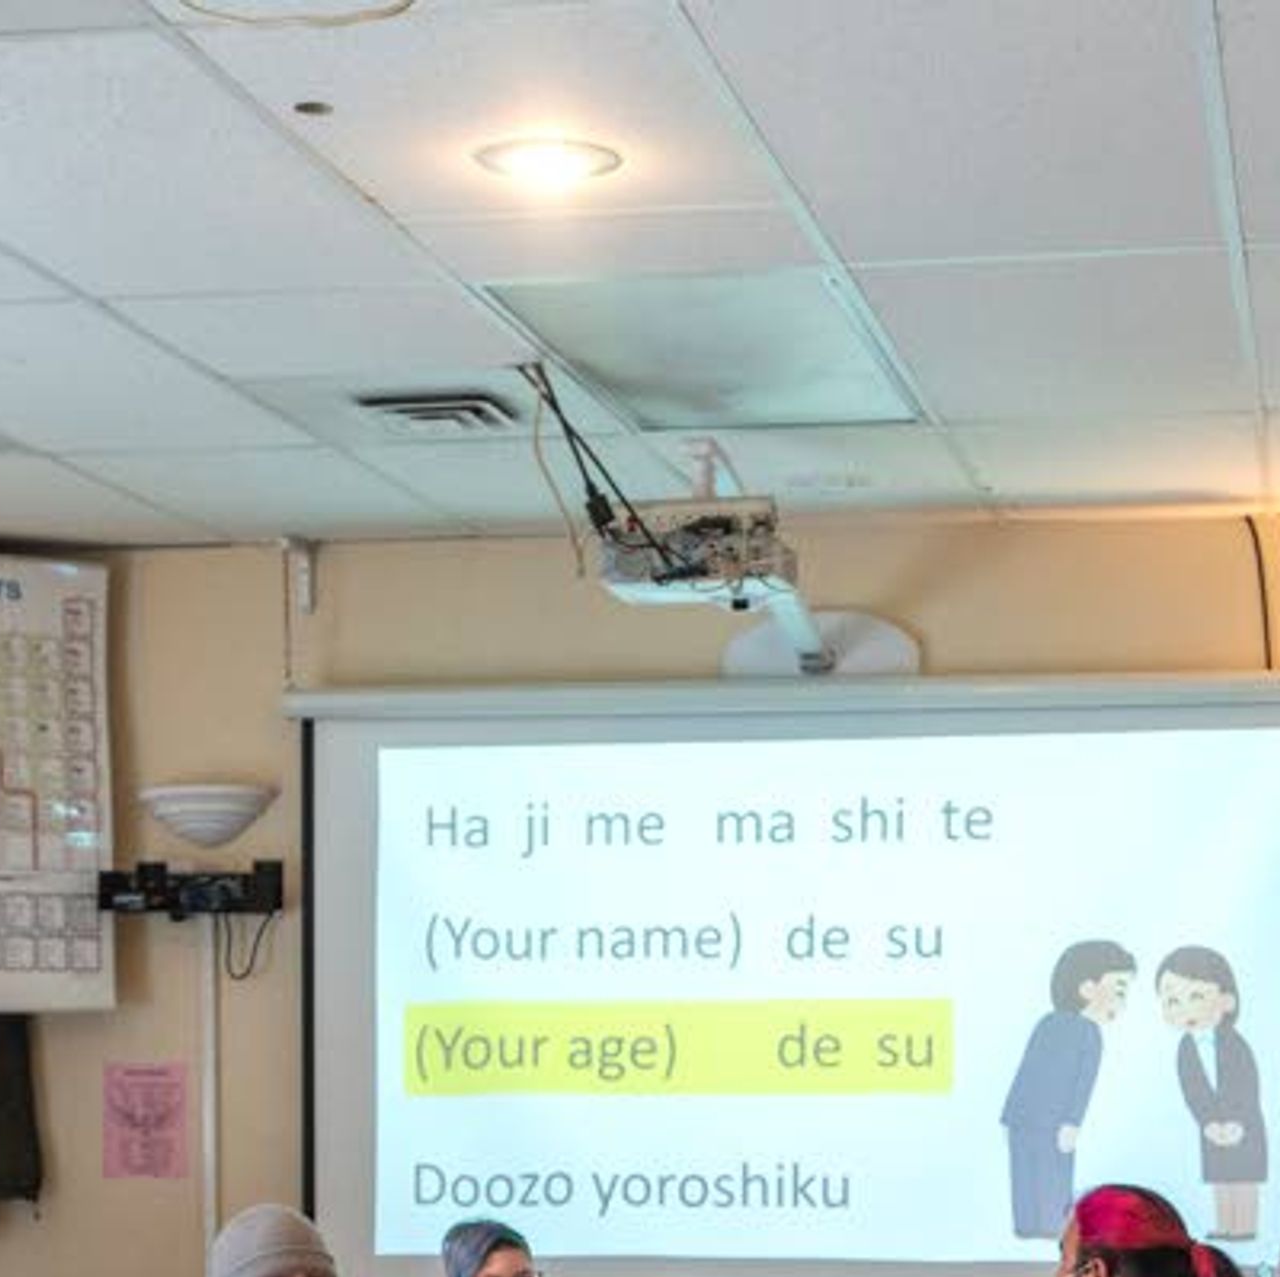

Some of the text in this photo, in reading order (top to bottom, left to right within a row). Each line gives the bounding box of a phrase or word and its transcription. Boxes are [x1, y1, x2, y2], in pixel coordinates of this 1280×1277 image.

[426, 796, 994, 859] Ha ji me ma shi te
[425, 912, 943, 972] (Your name) de su
[414, 1023, 934, 1084] (Your age) de su
[413, 1162, 851, 1217] Doozo yoroshiku
